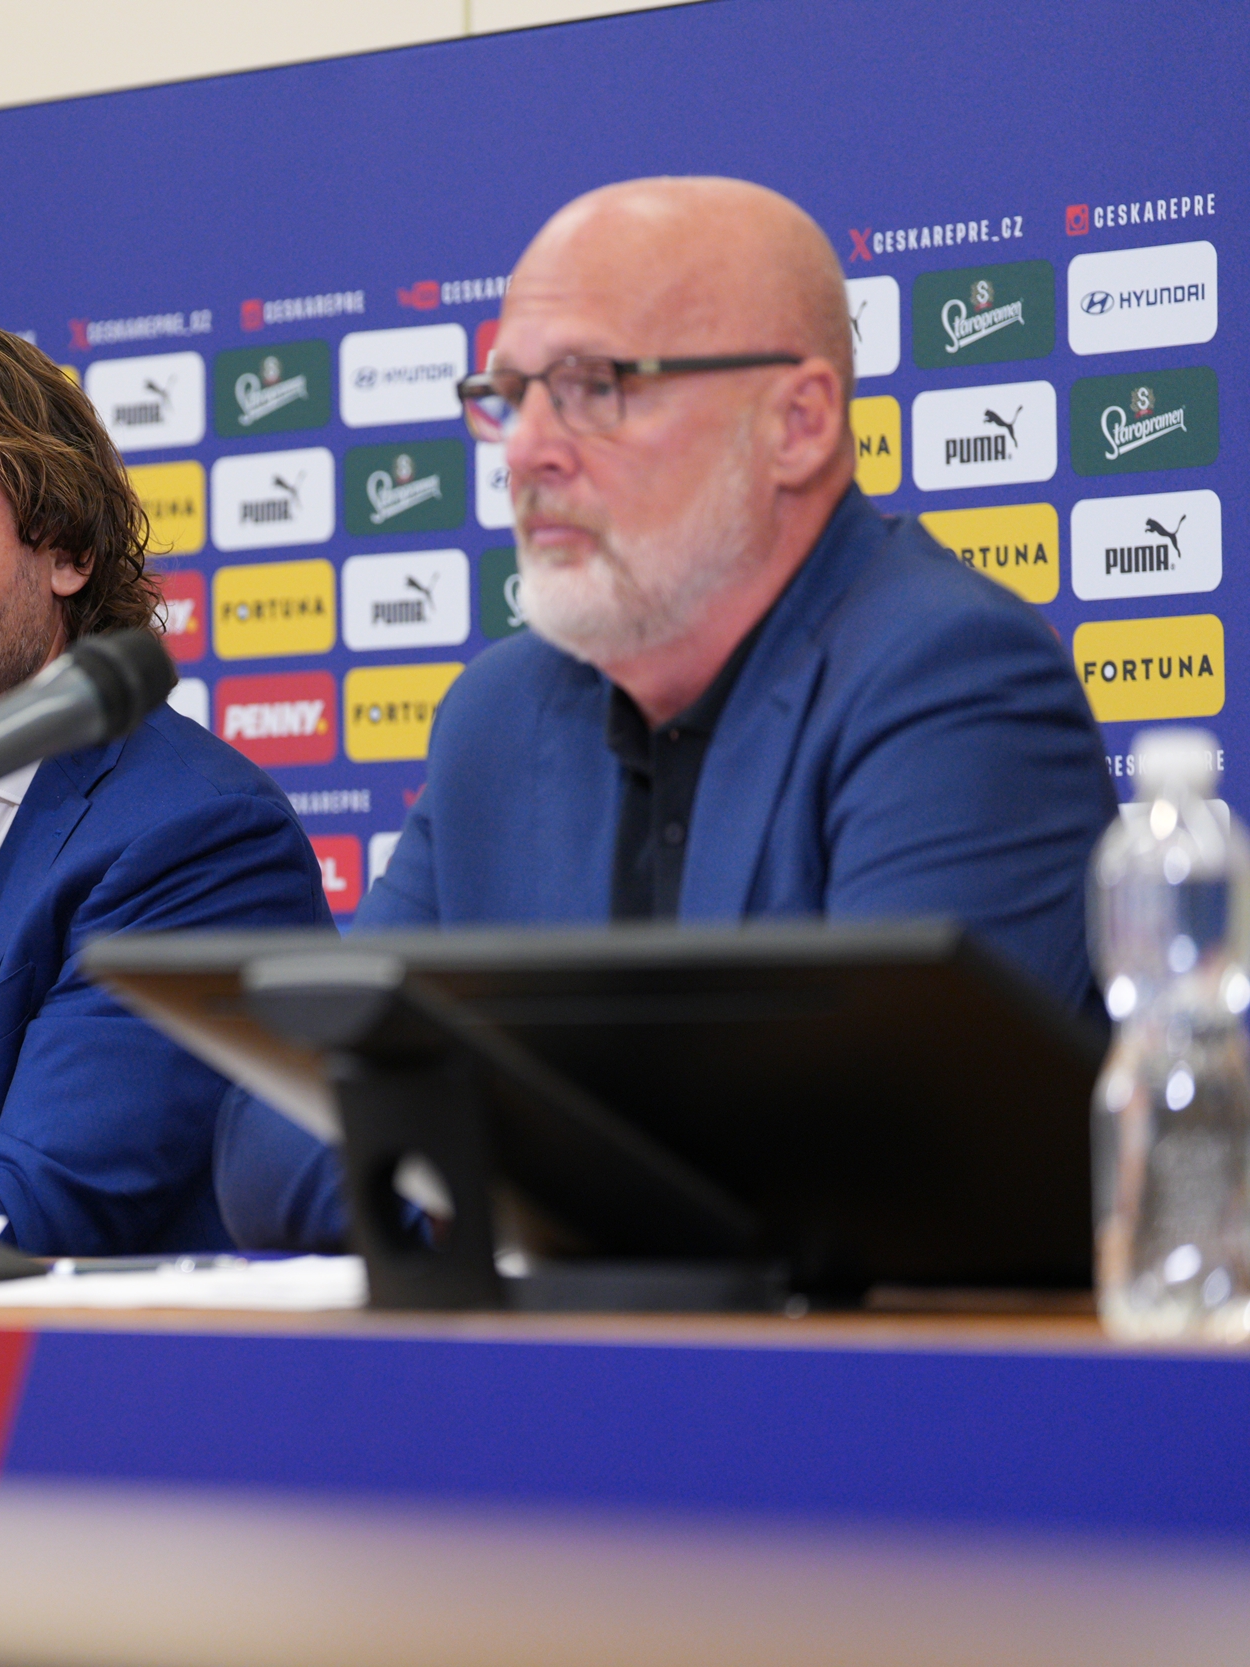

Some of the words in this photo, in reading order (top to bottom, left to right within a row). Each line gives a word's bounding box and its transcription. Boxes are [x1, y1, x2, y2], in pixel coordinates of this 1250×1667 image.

[1119, 282, 1206, 309] HYUNDAI
[941, 298, 1025, 354] Staropramen
[1100, 405, 1187, 461] Staropramen
[945, 434, 1006, 466] PUMA
[1105, 543, 1170, 575] PUMA
[1083, 653, 1215, 684] FORTUNA
